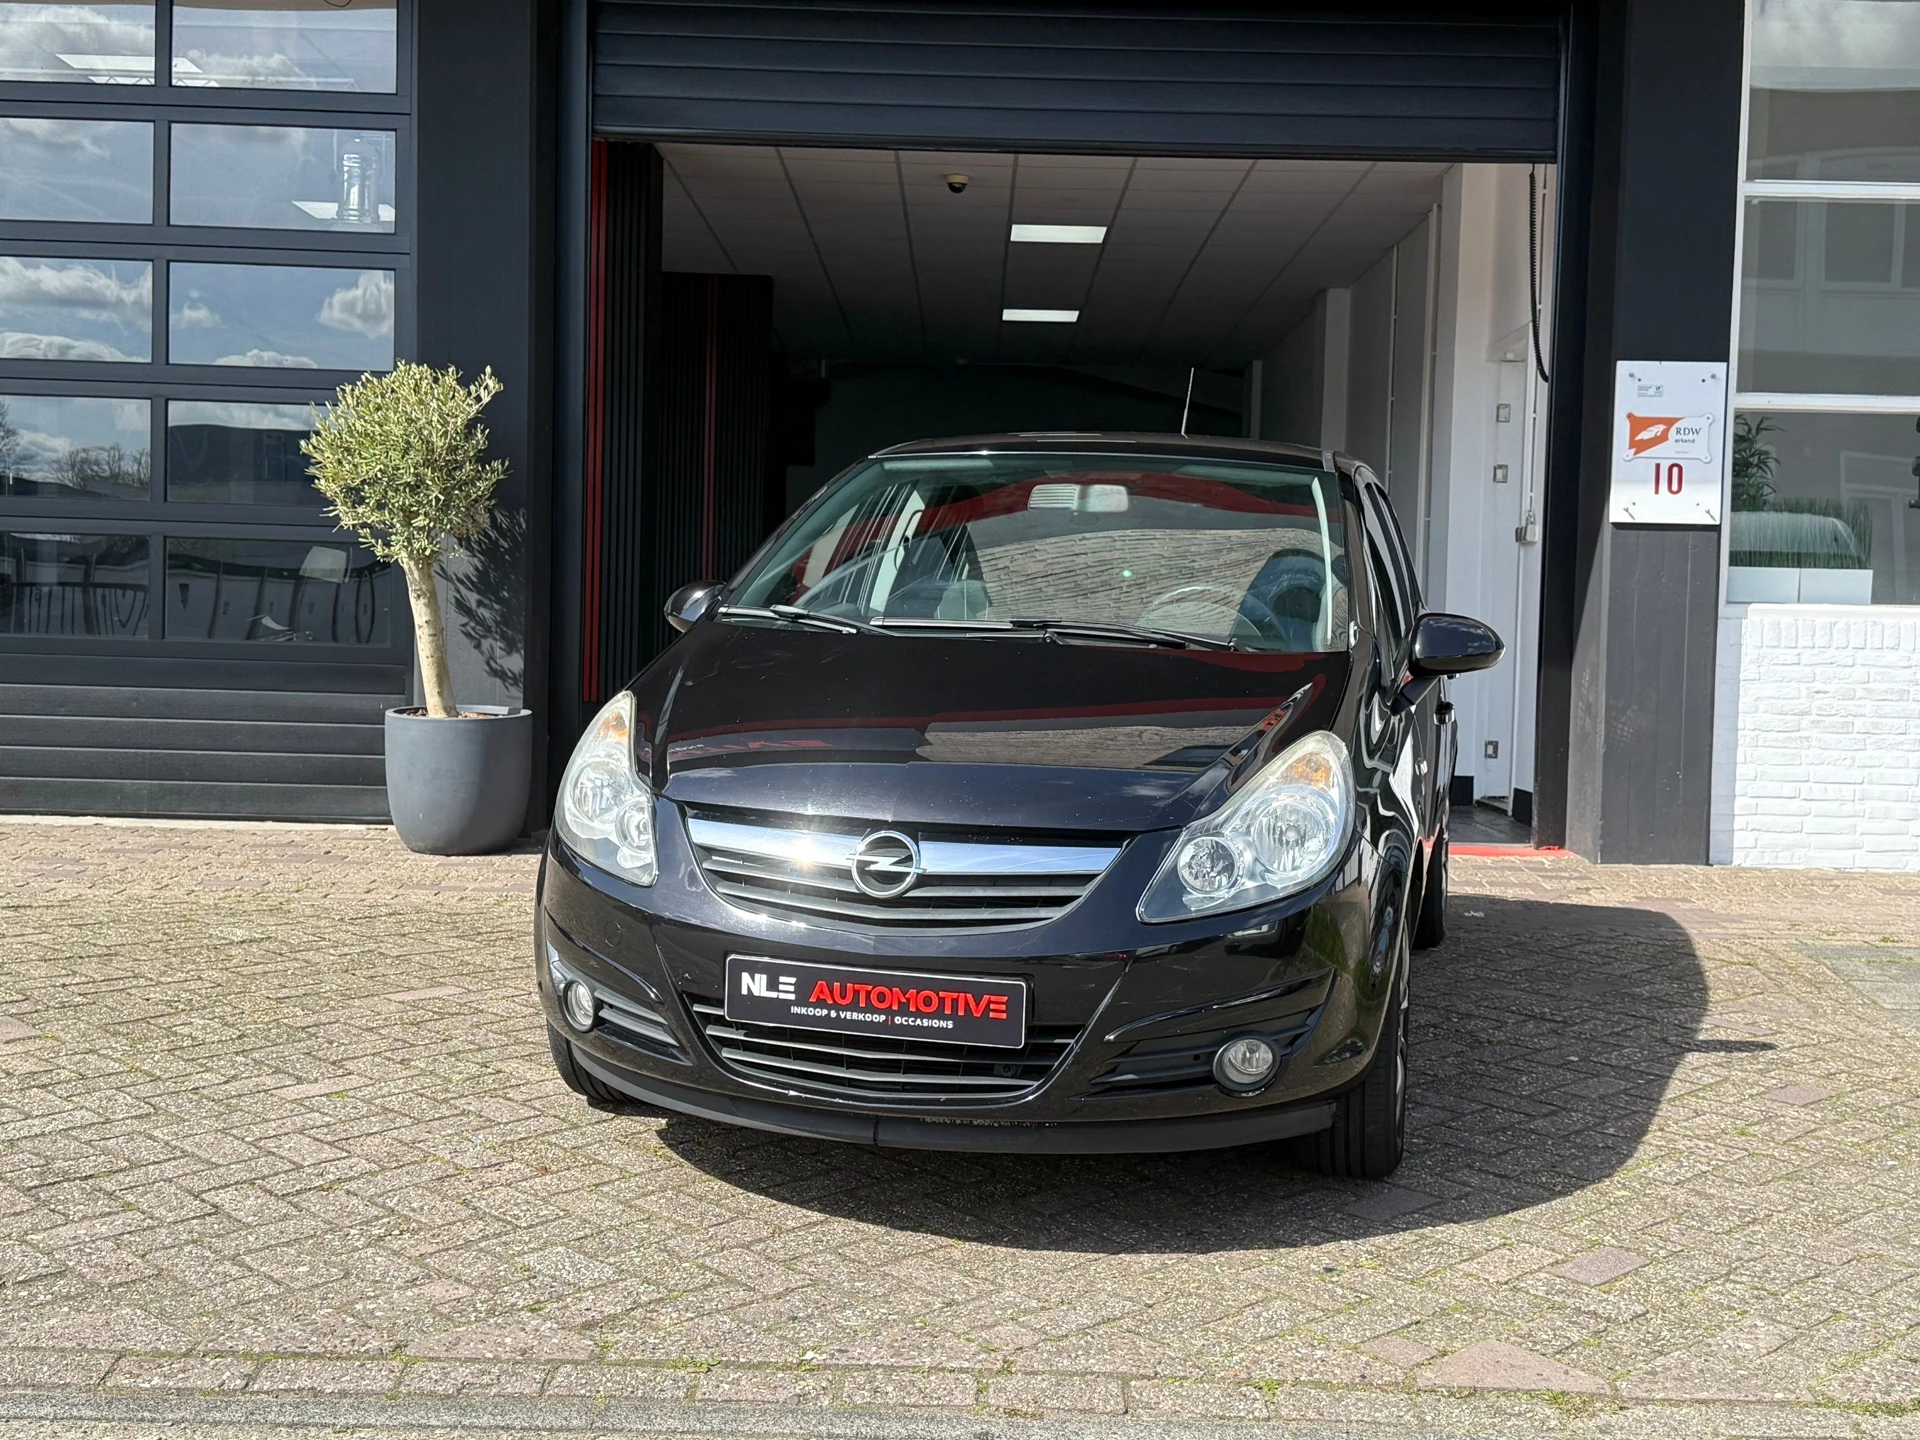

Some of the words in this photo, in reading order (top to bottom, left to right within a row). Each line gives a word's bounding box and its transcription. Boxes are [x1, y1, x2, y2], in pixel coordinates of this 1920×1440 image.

[1675, 427, 1701, 436] RDW
[1654, 463, 1683, 495] 10
[741, 971, 797, 1000] NLE
[808, 980, 1009, 1020] AUTOMOTIVE
[790, 1005, 828, 1017] INKOOP
[830, 1009, 837, 1018] &
[839, 1010, 887, 1023] VERKOOP
[894, 1016, 954, 1029] OCCASIONS
